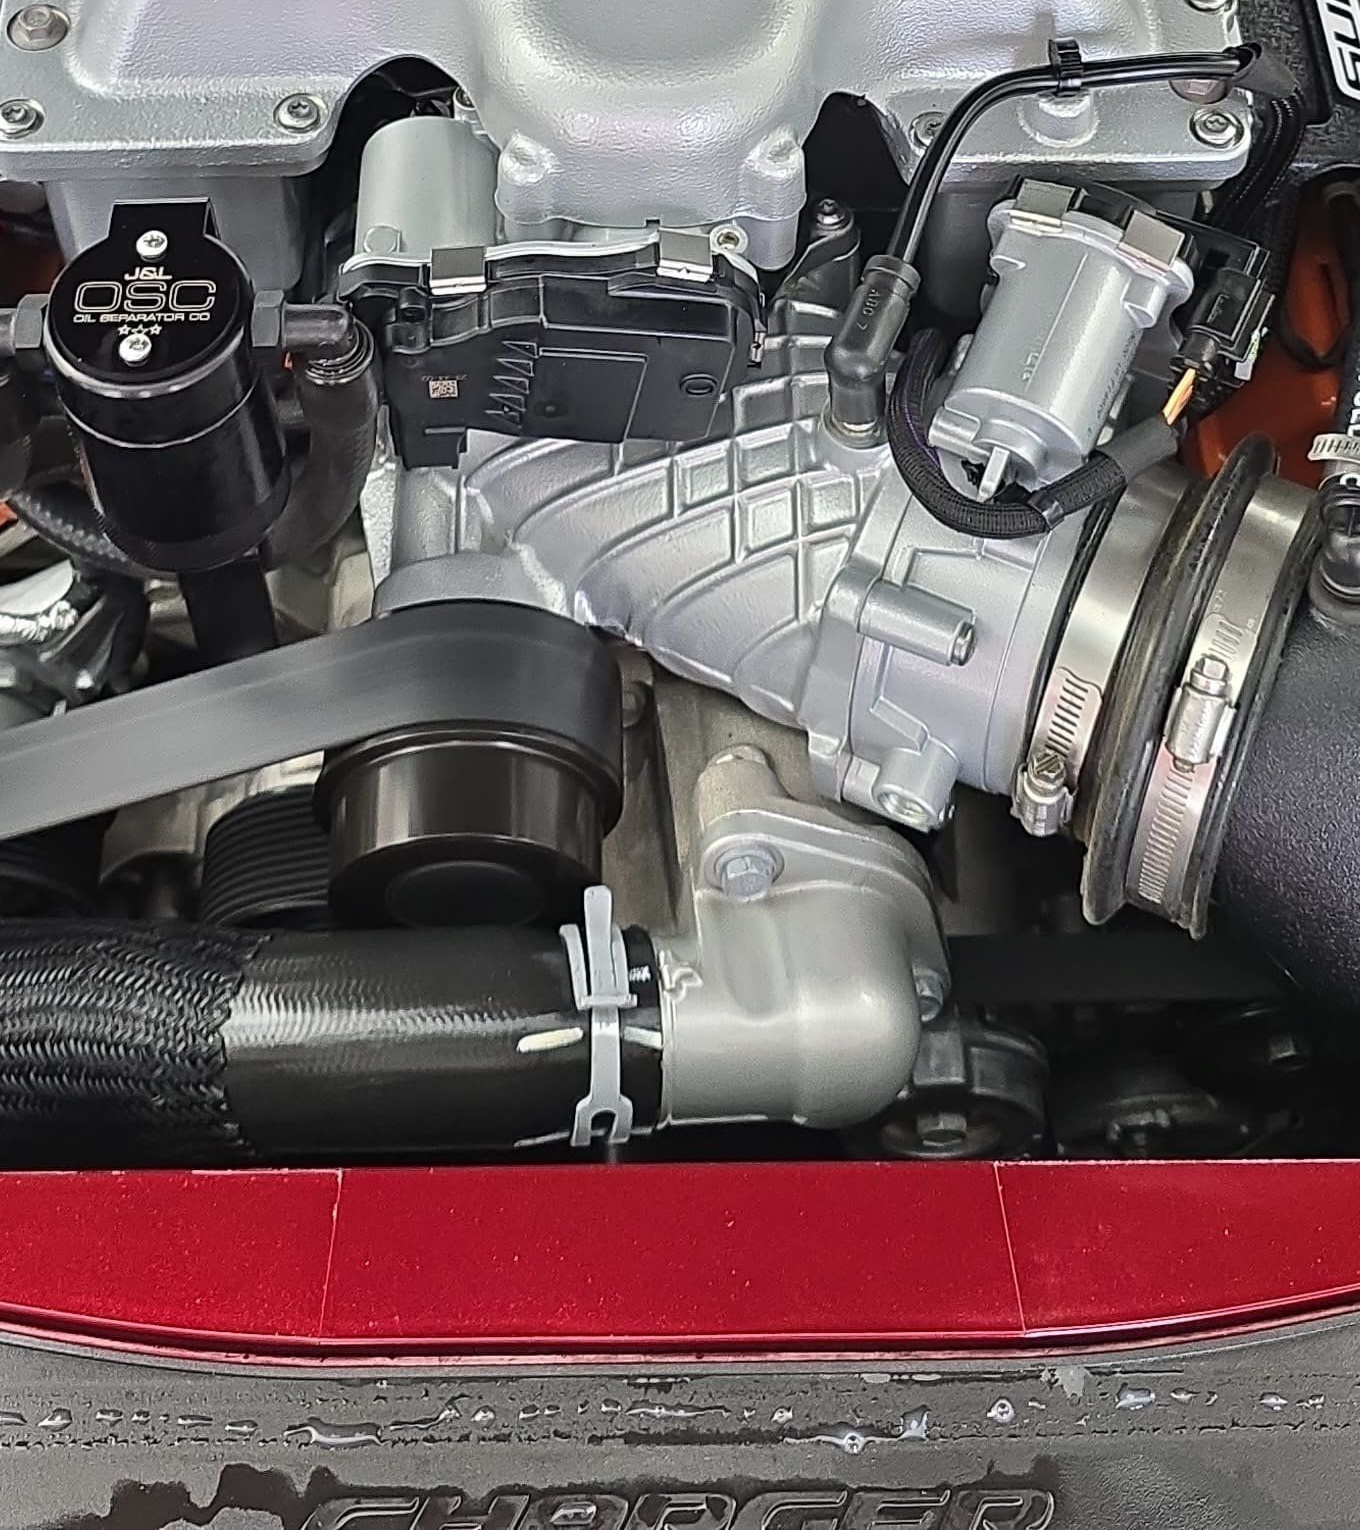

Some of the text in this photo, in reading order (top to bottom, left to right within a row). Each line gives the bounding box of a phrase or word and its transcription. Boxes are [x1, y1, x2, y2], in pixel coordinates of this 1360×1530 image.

[124, 266, 173, 281] J&L
[74, 280, 217, 313] OSC
[73, 312, 211, 323] OIL SEPARATOR CO
